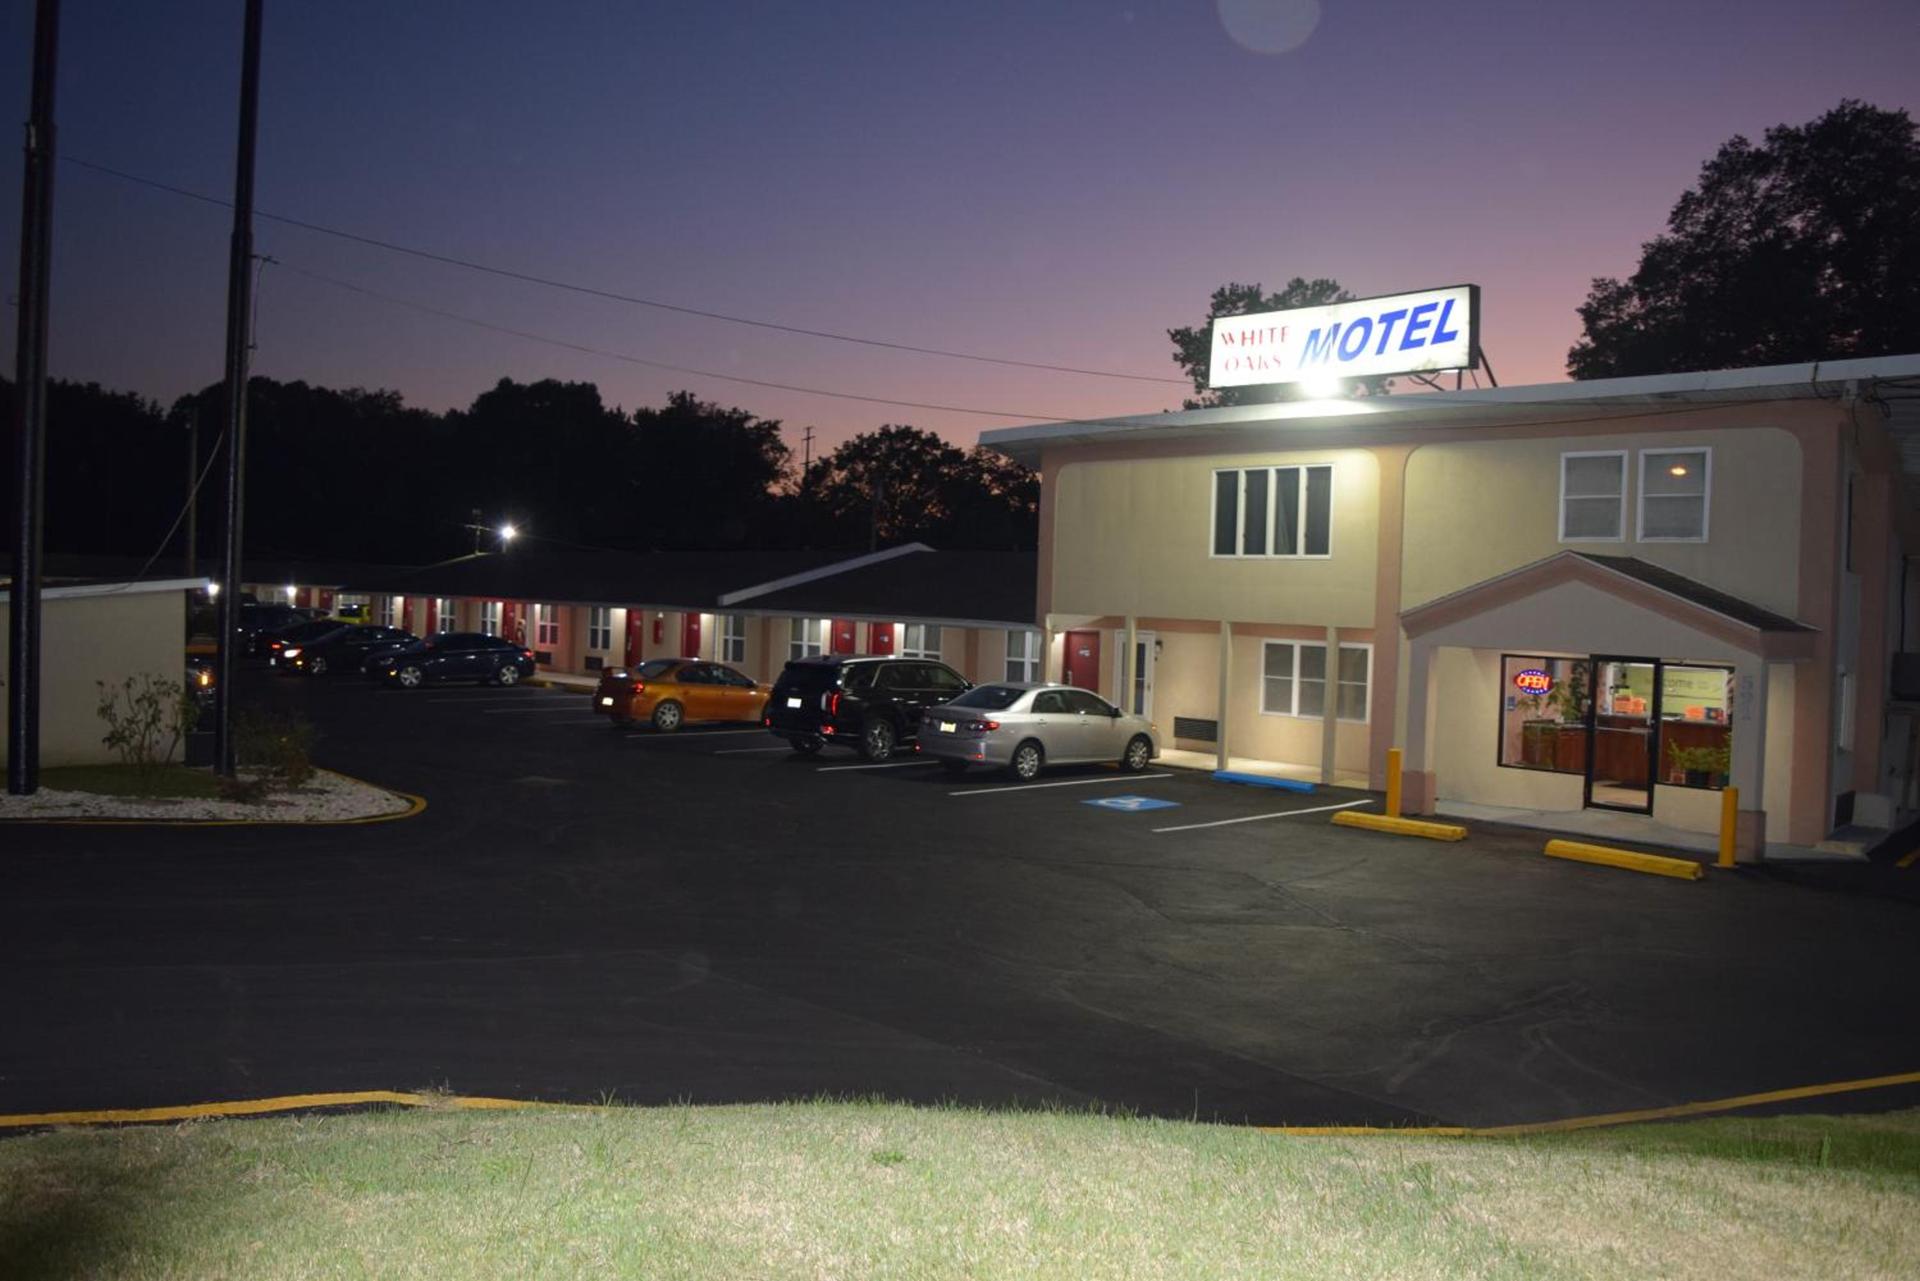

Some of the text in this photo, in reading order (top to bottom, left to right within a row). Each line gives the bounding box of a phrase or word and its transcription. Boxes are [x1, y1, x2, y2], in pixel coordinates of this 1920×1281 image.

[1221, 325, 1290, 347] WHITE
[1298, 299, 1459, 369] MOTEL
[1516, 675, 1550, 688] OPEN
